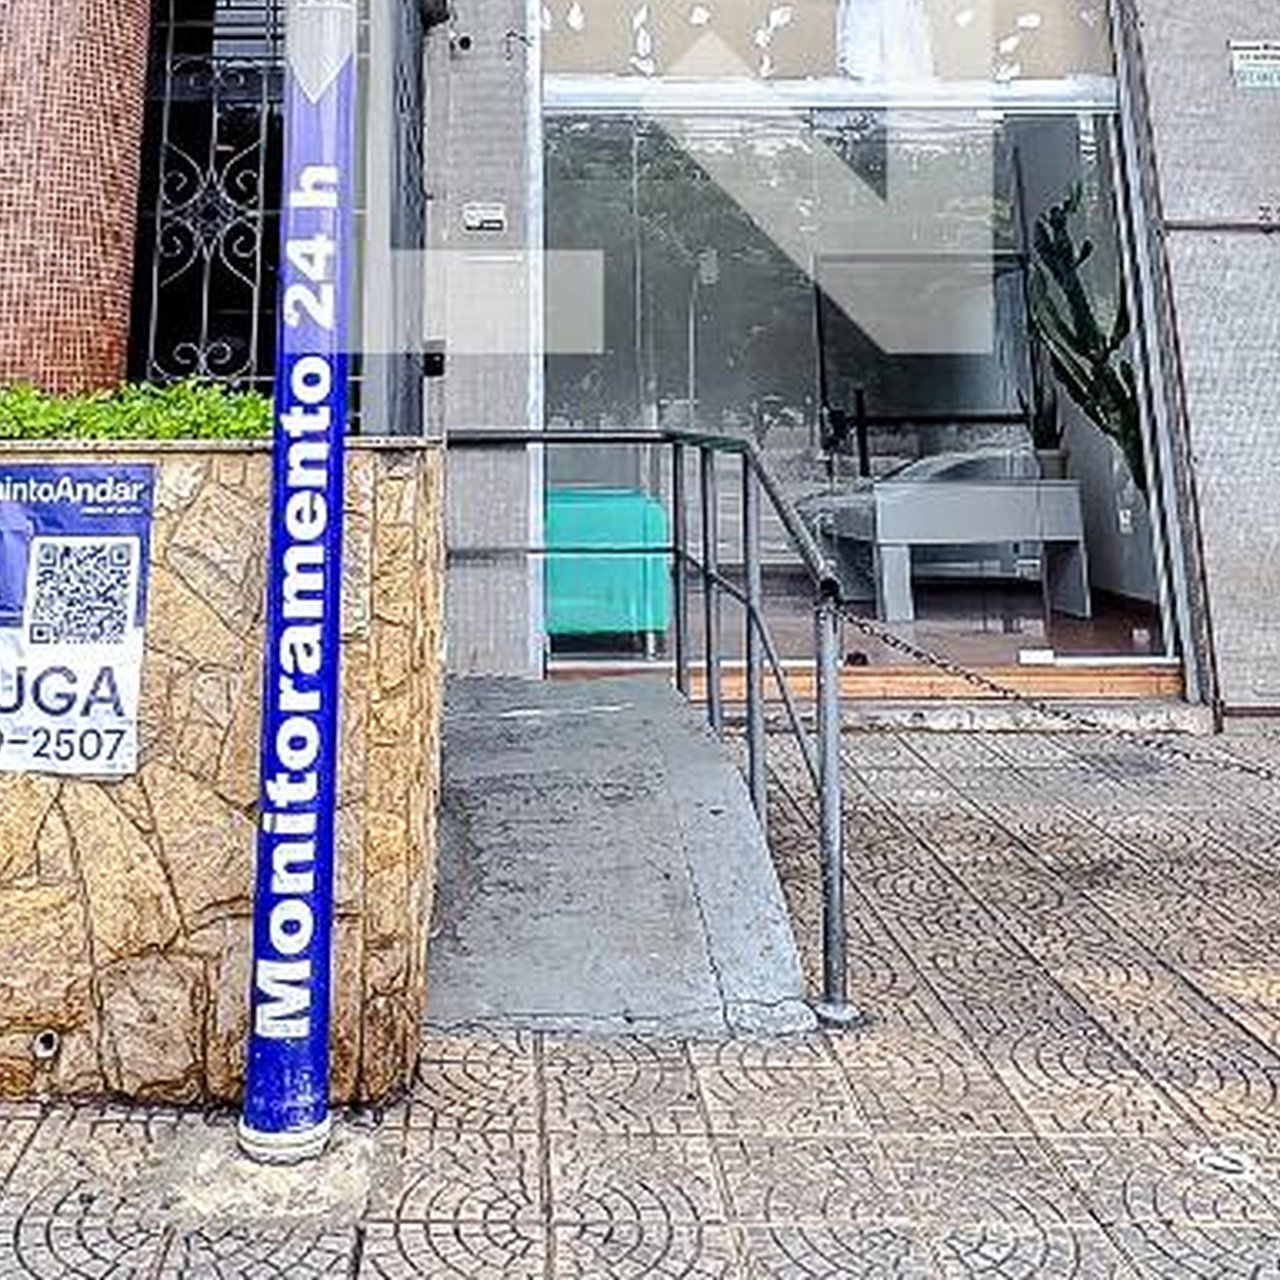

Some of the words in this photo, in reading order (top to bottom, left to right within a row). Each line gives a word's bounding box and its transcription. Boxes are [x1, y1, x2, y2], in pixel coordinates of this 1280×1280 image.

[289, 164, 339, 209] h
[283, 232, 336, 331] 24
[255, 354, 332, 1040] Monitoramento
